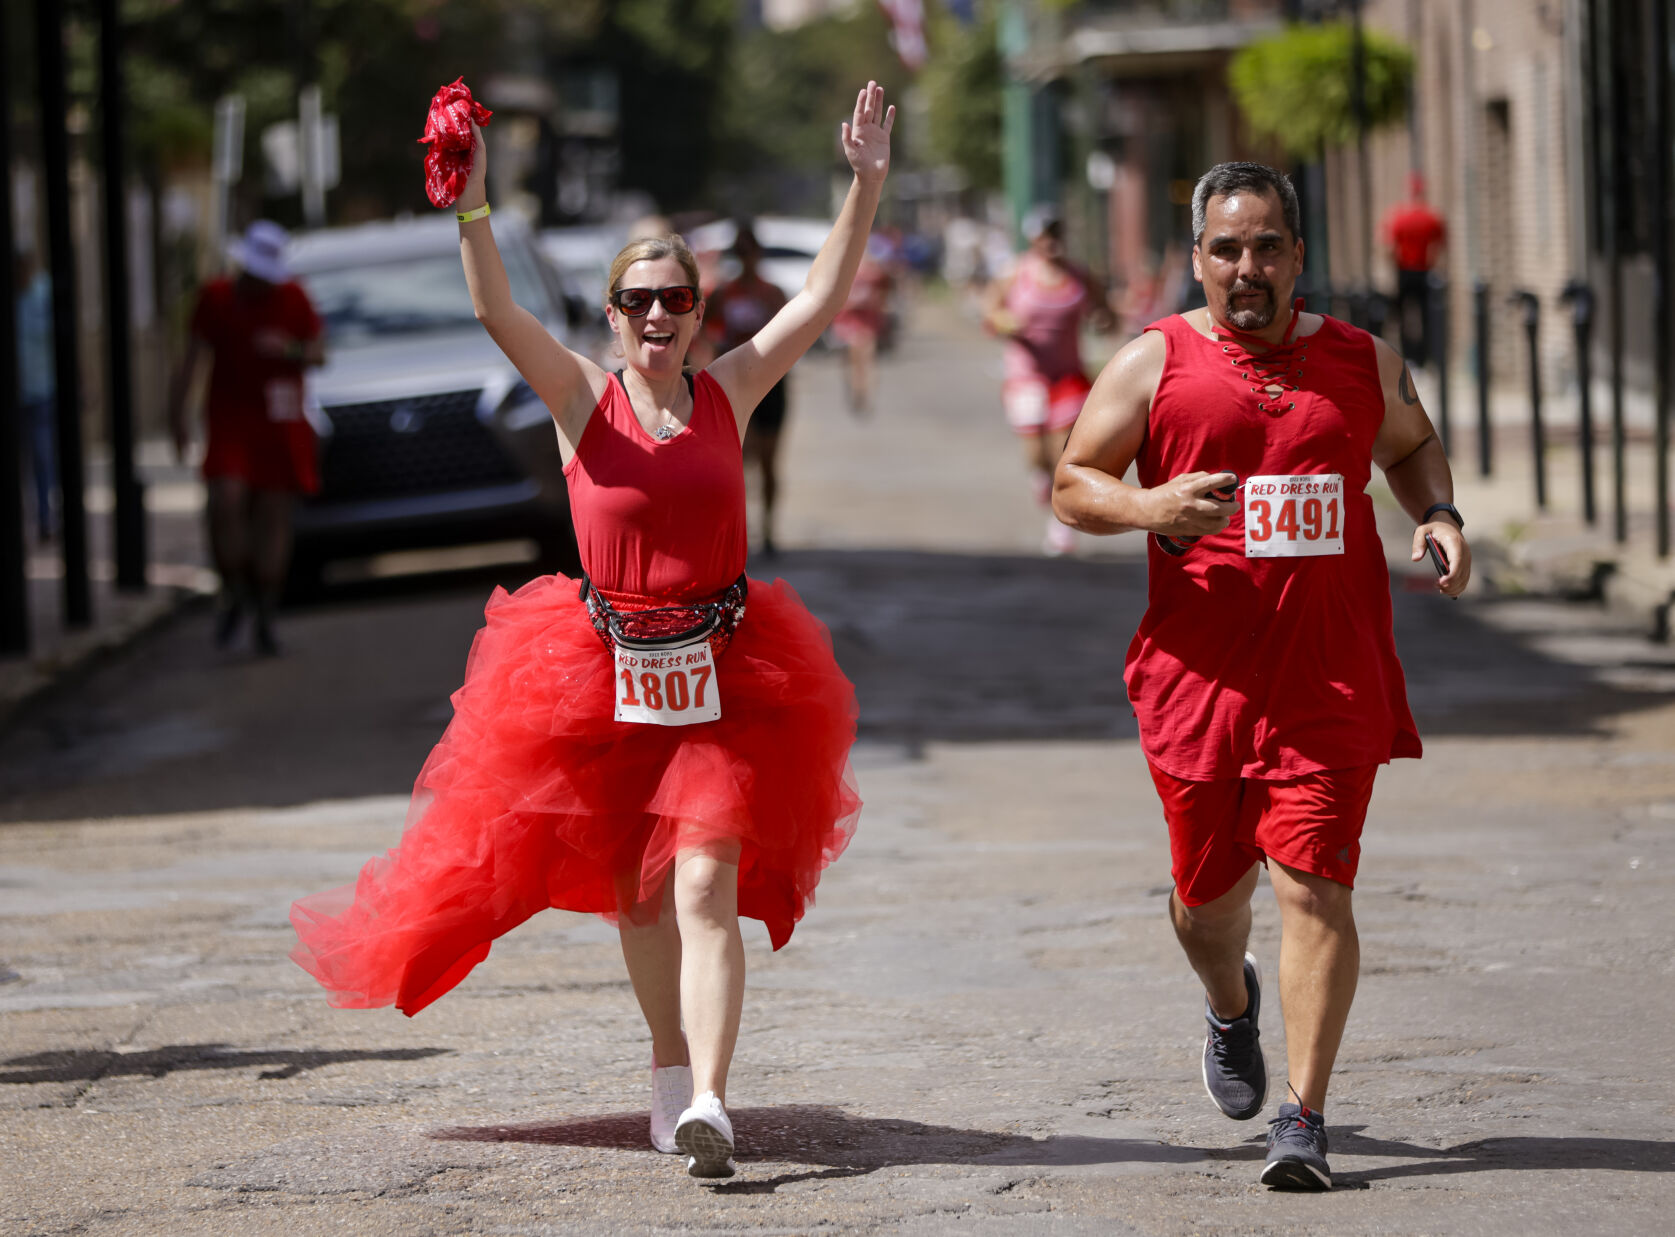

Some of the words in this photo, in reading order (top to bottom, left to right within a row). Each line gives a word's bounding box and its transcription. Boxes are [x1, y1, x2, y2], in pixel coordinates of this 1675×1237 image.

[1251, 484, 1276, 495] RED
[1280, 483, 1319, 494] DRESS
[1322, 483, 1338, 494] RUN
[1249, 498, 1339, 542] 3491
[618, 654, 638, 667] RED
[642, 656, 682, 669] DRESS
[686, 650, 706, 665] RUN
[621, 664, 711, 711] 1807
